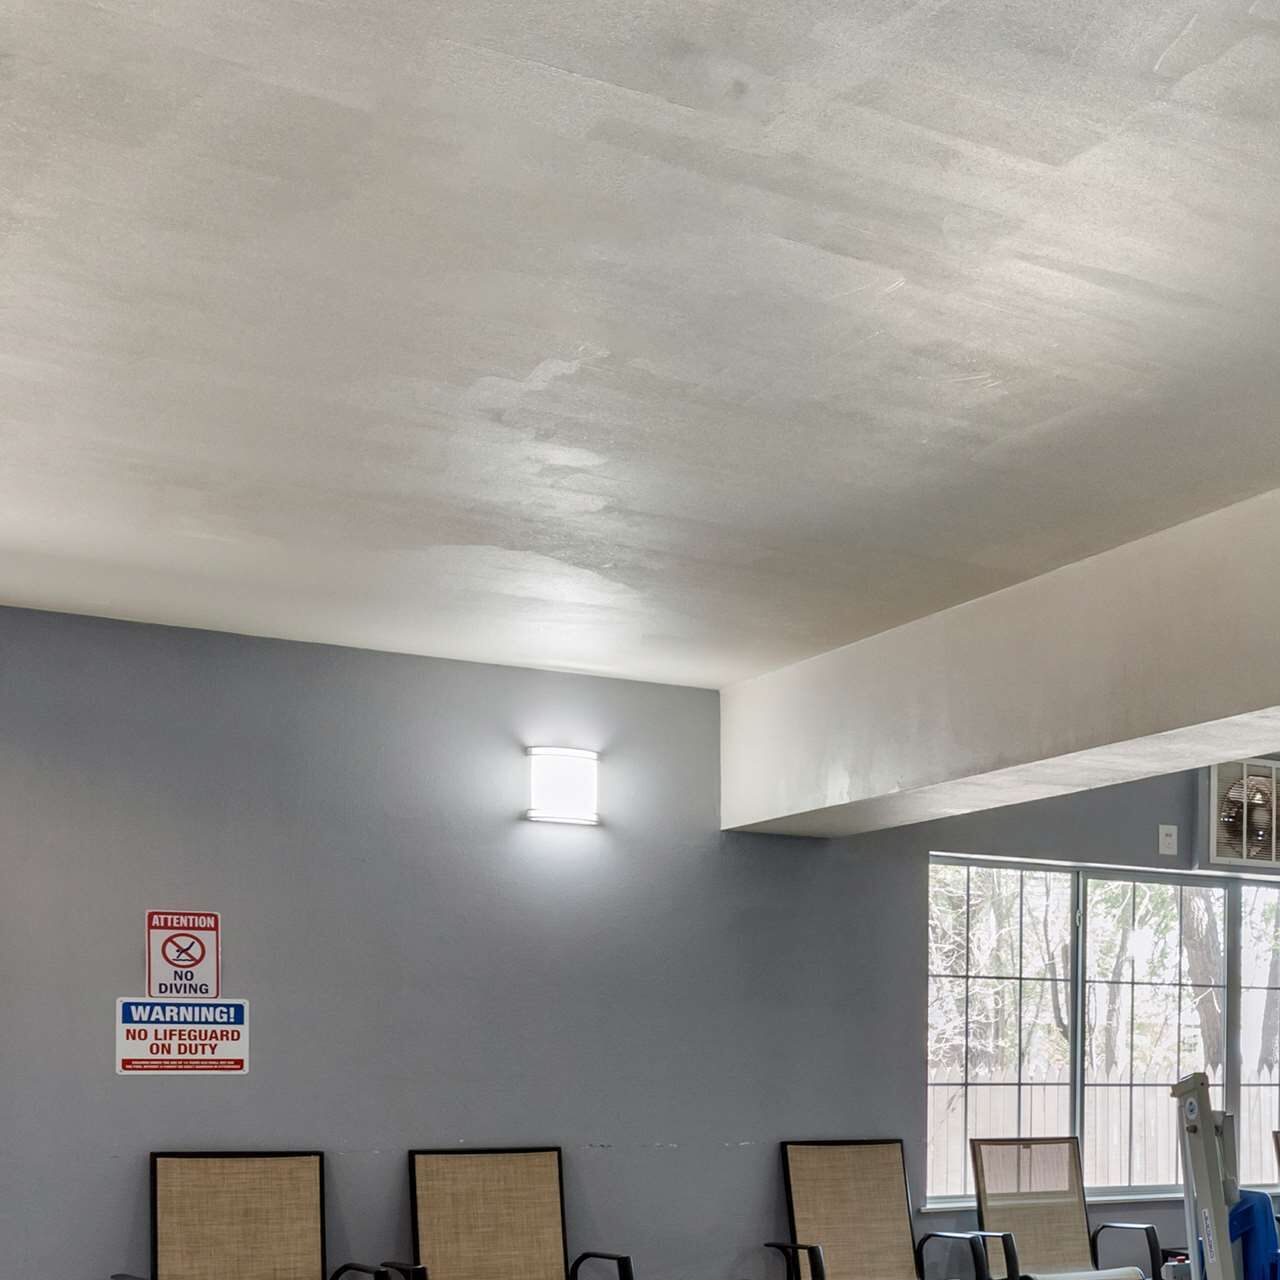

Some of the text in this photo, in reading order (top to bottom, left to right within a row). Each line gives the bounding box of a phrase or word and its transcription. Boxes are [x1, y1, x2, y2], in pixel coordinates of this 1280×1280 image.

[152, 915, 215, 928] ATTENTION
[174, 970, 194, 981] NO
[159, 983, 209, 994] DIVING
[130, 1005, 235, 1022] WARNING!
[126, 1029, 240, 1041] NO LIFEGUARD
[150, 1043, 218, 1055] ON DUTY
